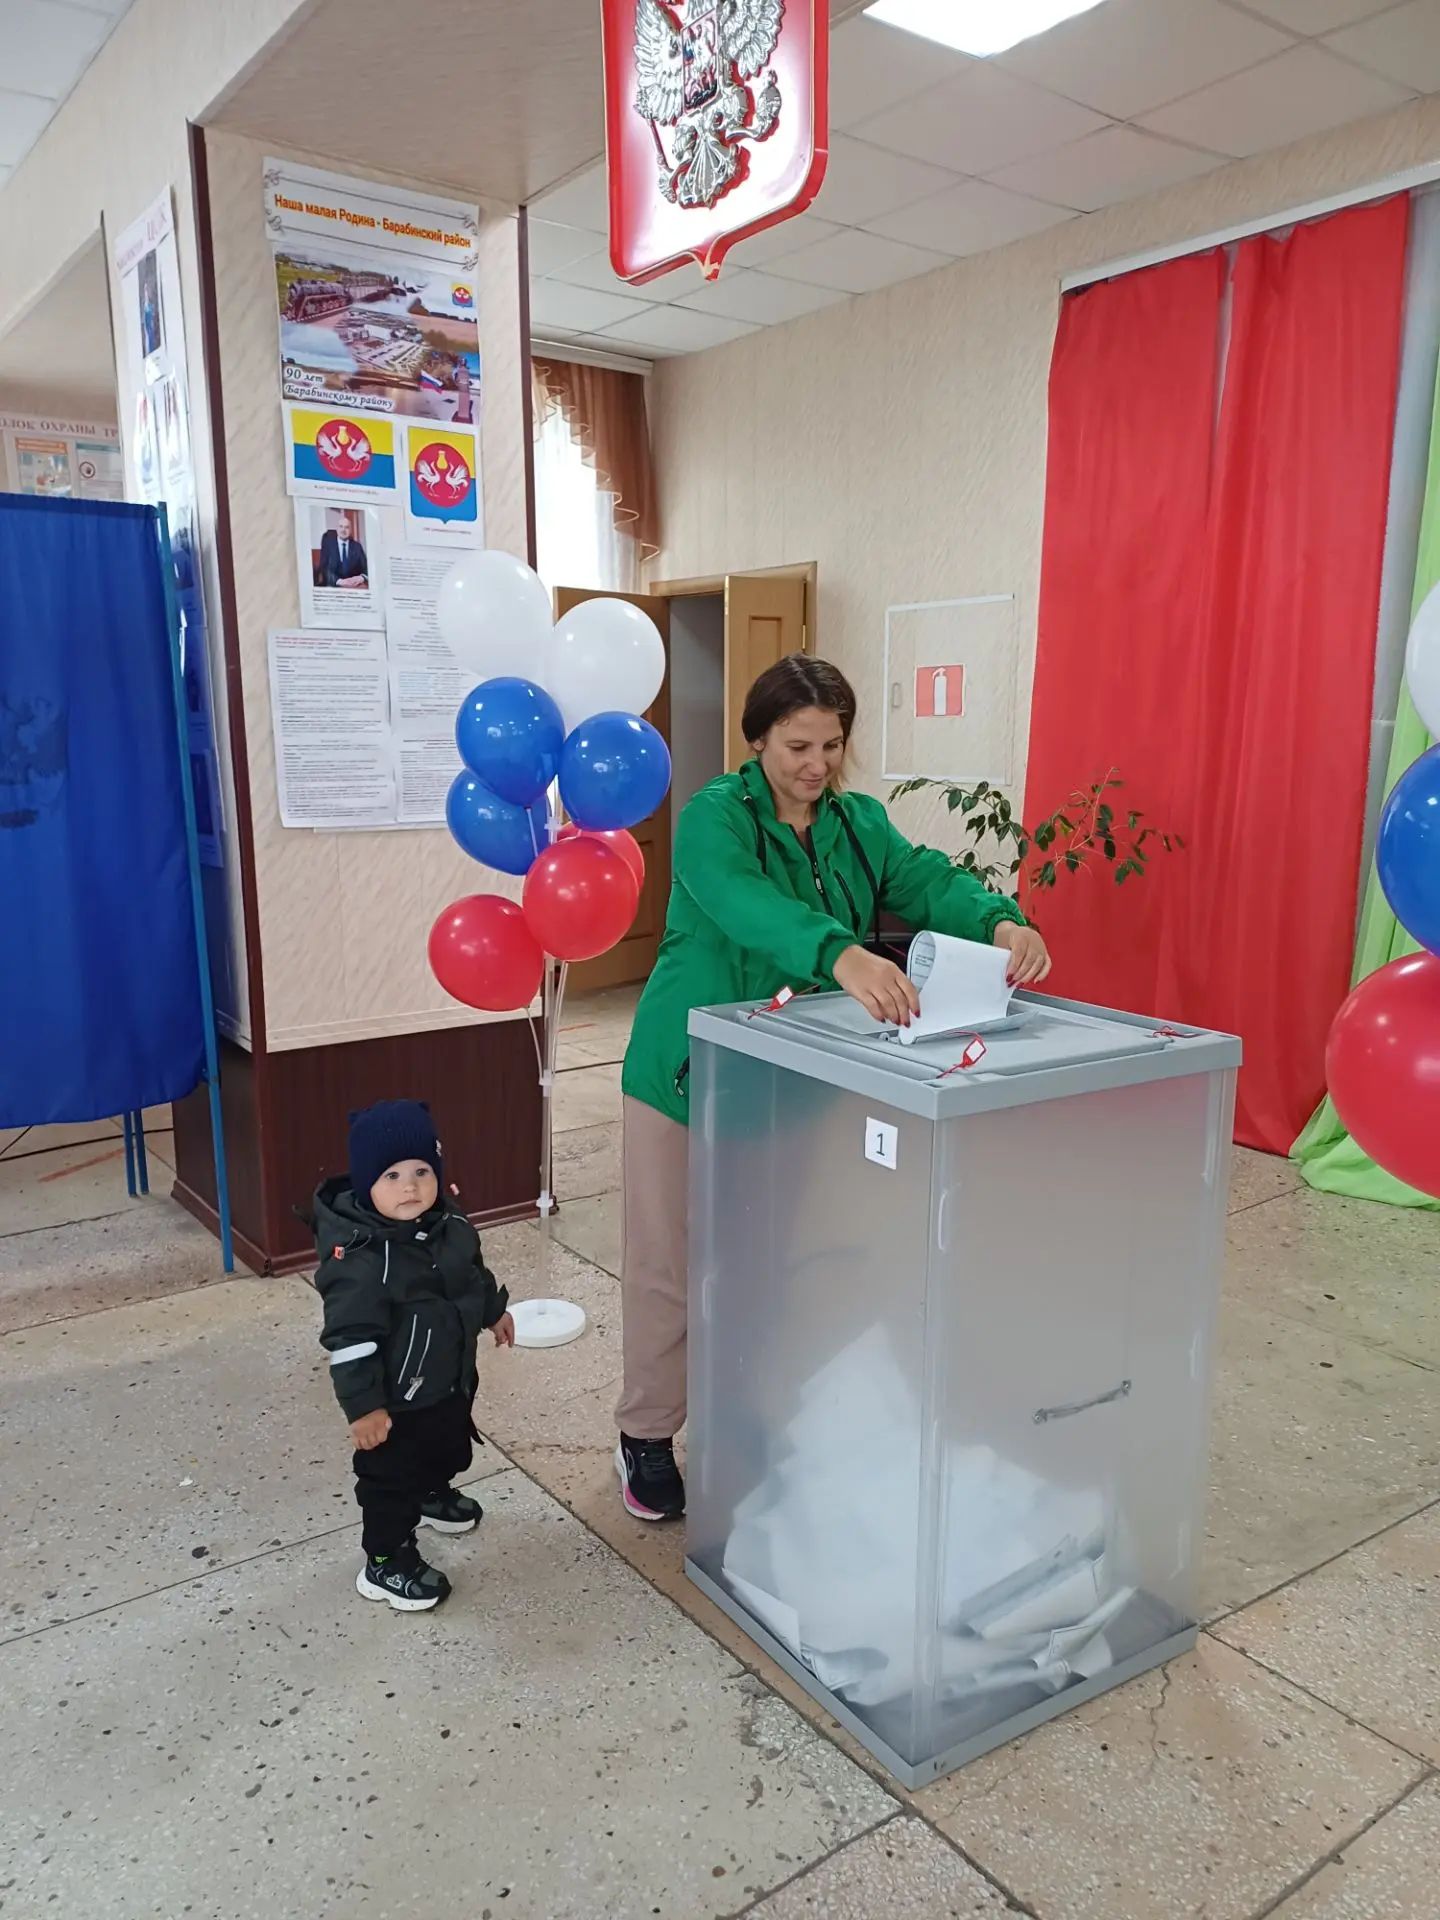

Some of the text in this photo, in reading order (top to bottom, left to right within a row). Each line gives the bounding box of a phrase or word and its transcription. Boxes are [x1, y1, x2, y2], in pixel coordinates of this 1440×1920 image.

[274, 194, 303, 212] Наша
[306, 204, 337, 219] малая
[339, 208, 375, 228] Родина
[383, 217, 443, 241] Барабинский
[444, 230, 471, 248] район
[286, 368, 323, 383] 90 лет
[285, 384, 393, 410] Барабинскому району
[40, 420, 96, 435] ОХРАНЫ
[876, 1132, 885, 1156] 1
